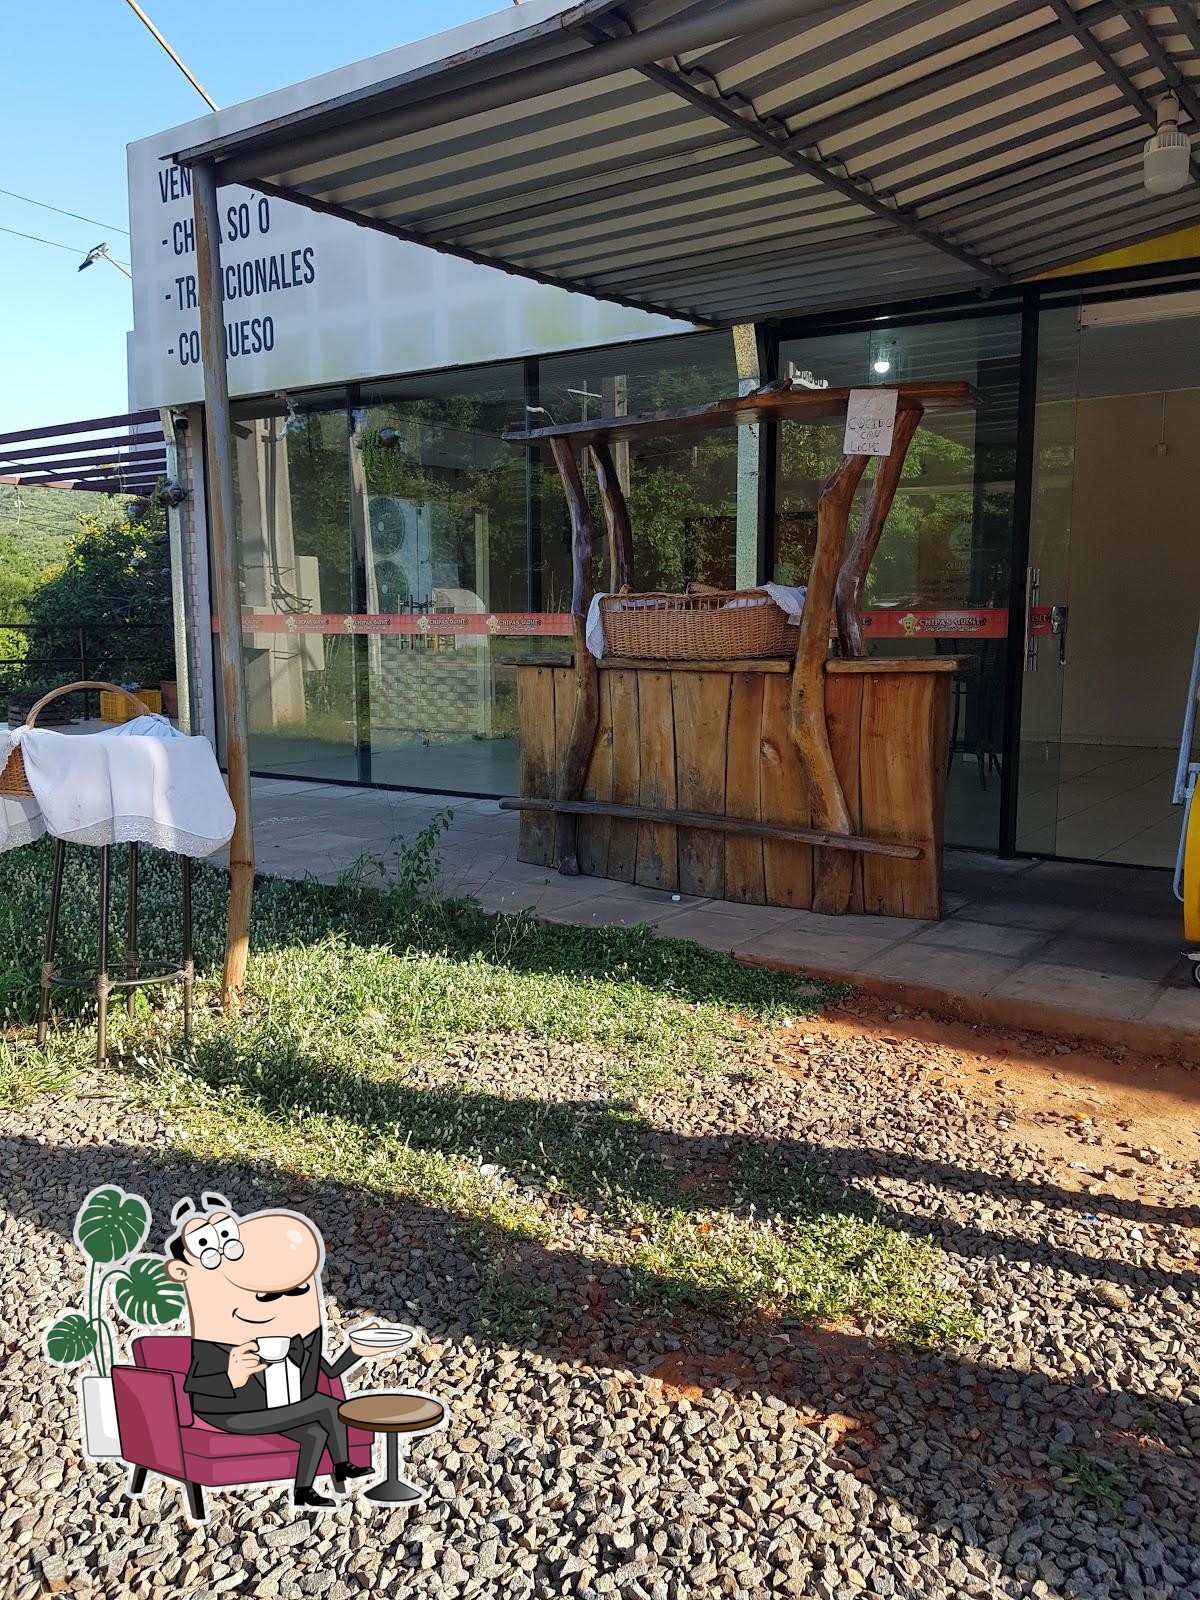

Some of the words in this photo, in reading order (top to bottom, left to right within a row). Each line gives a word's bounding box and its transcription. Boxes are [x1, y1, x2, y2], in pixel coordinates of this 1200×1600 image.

[158, 166, 192, 203] VEN
[178, 330, 203, 366] CO
[848, 416, 894, 430] COCIDO
